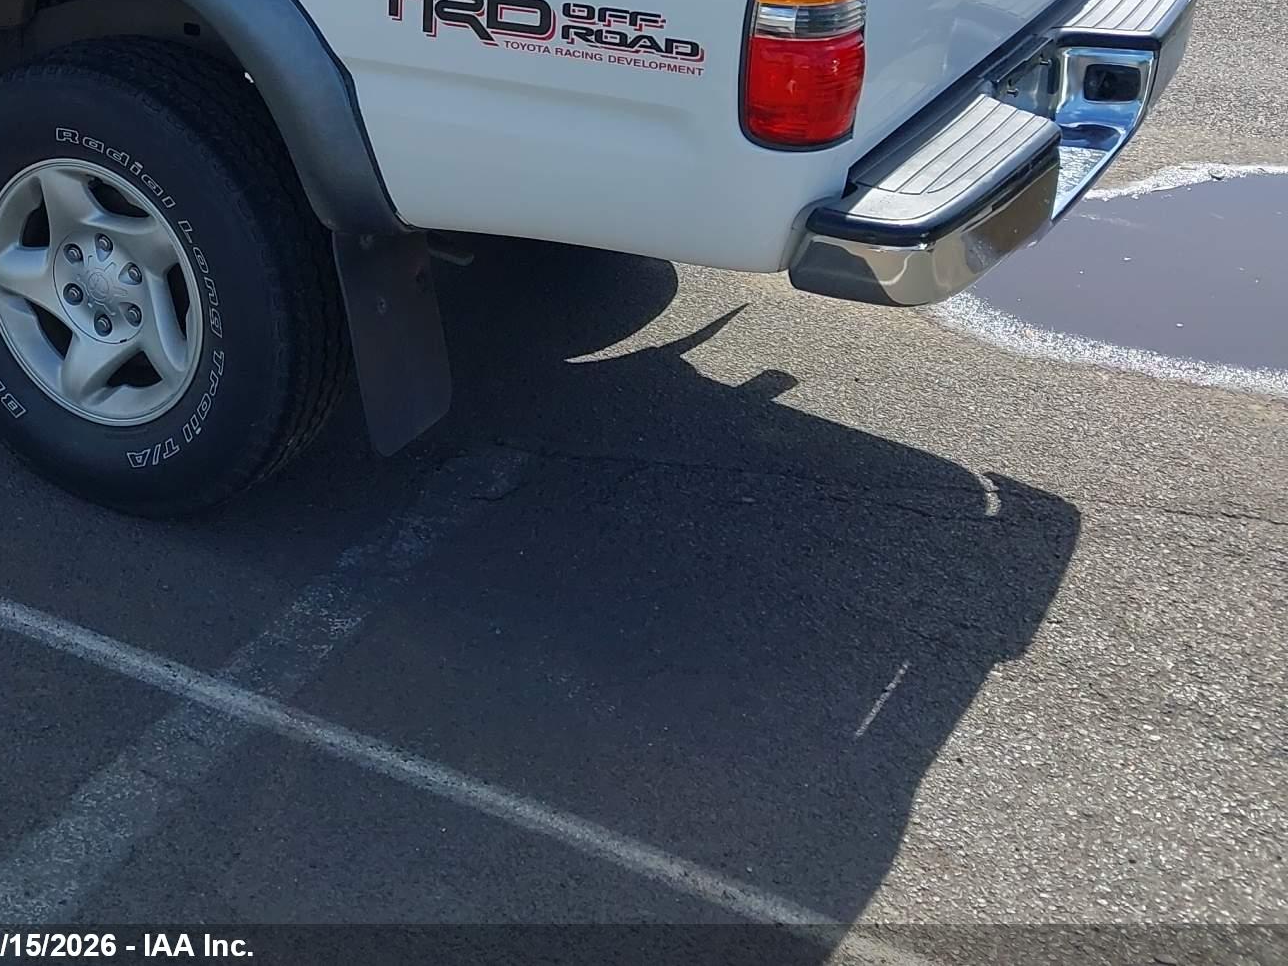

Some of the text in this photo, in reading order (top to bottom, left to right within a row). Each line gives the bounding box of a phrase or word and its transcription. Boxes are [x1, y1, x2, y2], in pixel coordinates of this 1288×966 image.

[562, 2, 667, 32] OFF
[503, 40, 705, 77] TOYOTA RACING DEVELOPMENT
[561, 24, 705, 62] ROAD
[55, 127, 225, 468] Radial Long Trail T/A
